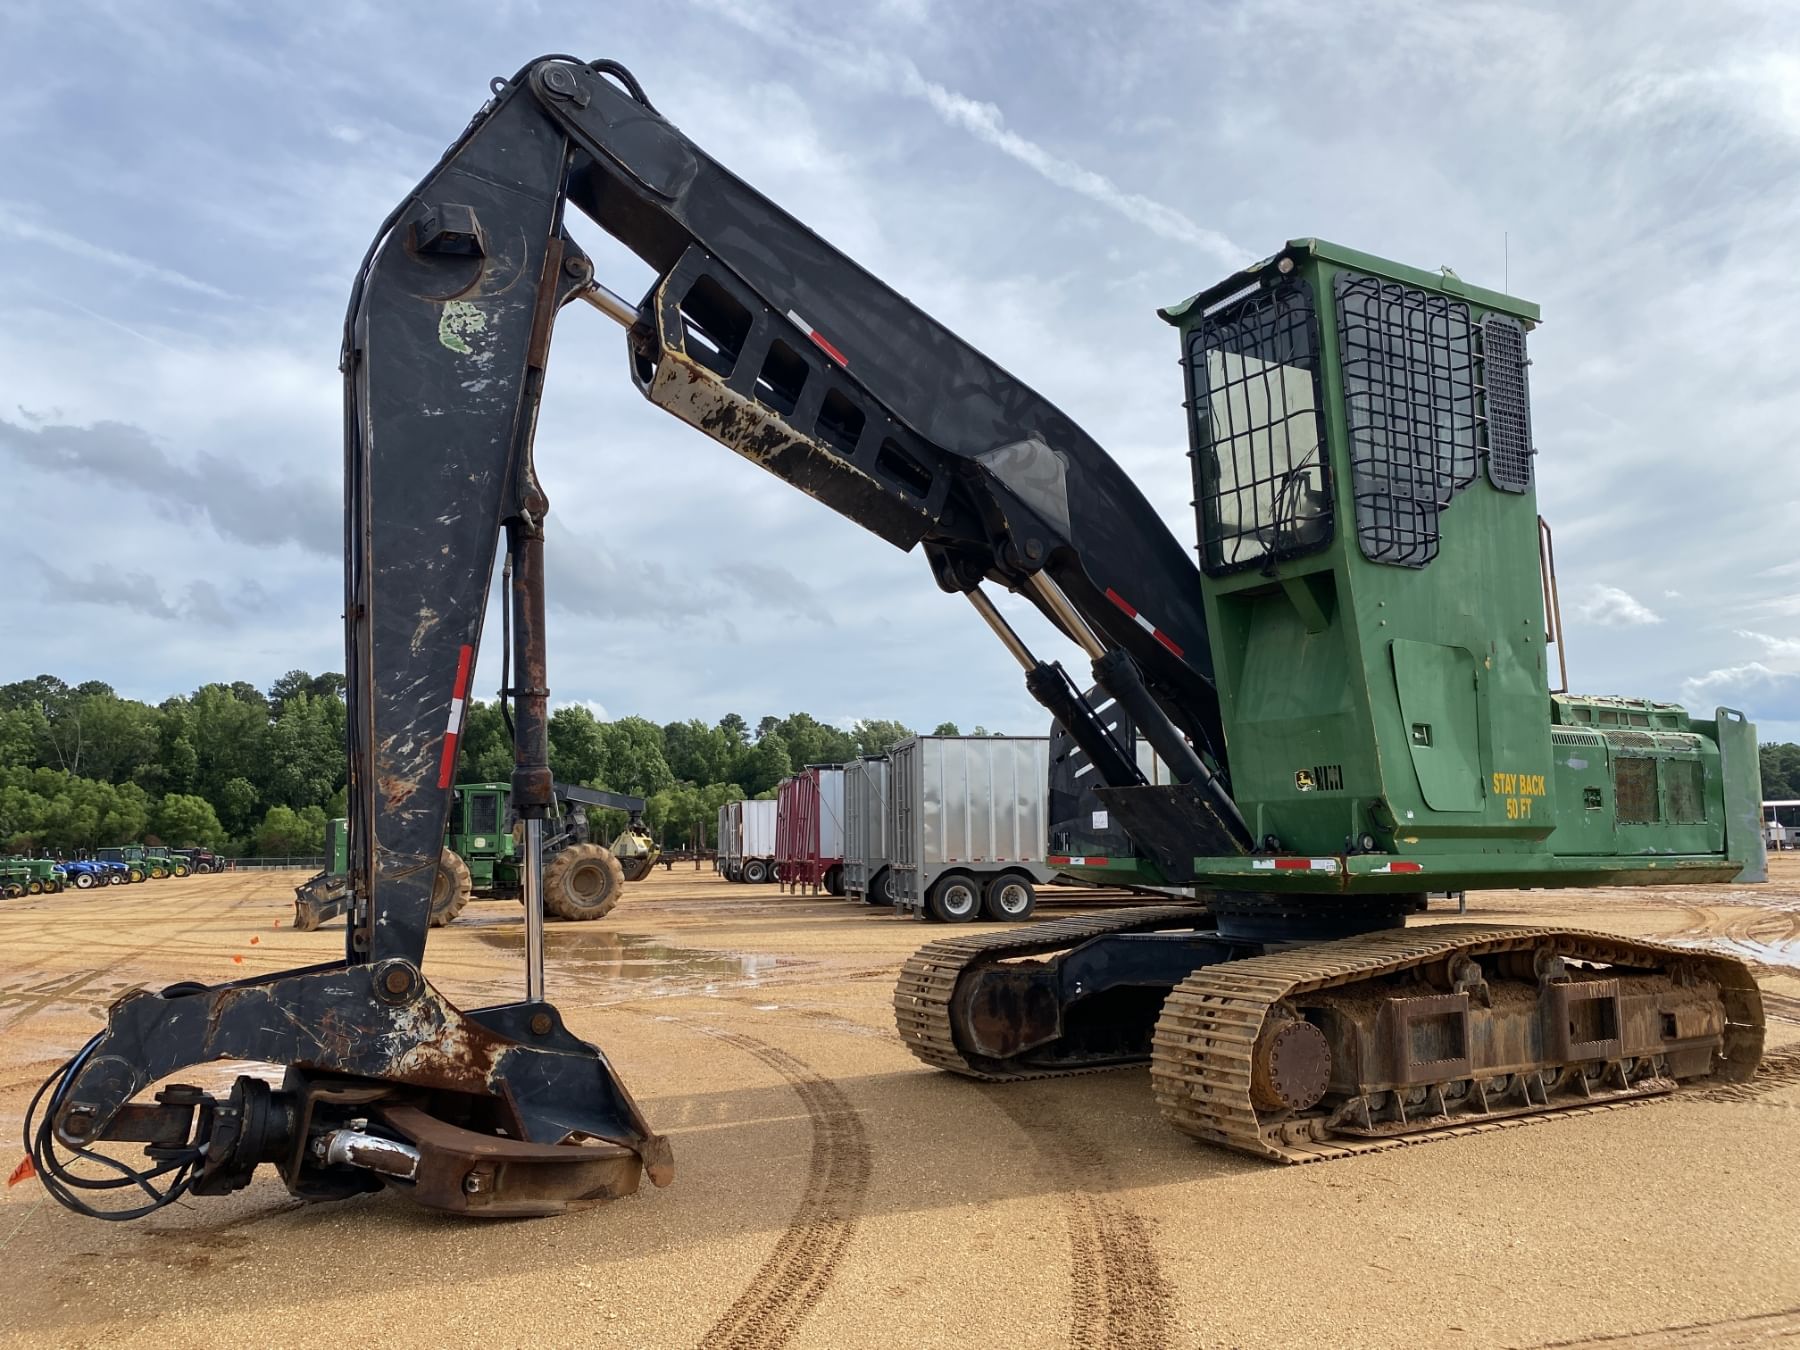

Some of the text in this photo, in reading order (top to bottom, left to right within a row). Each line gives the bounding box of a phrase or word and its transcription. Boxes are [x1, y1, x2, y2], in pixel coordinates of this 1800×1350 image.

[1493, 773, 1546, 797] STAY BACK
[1506, 798, 1532, 819] 50 FT
